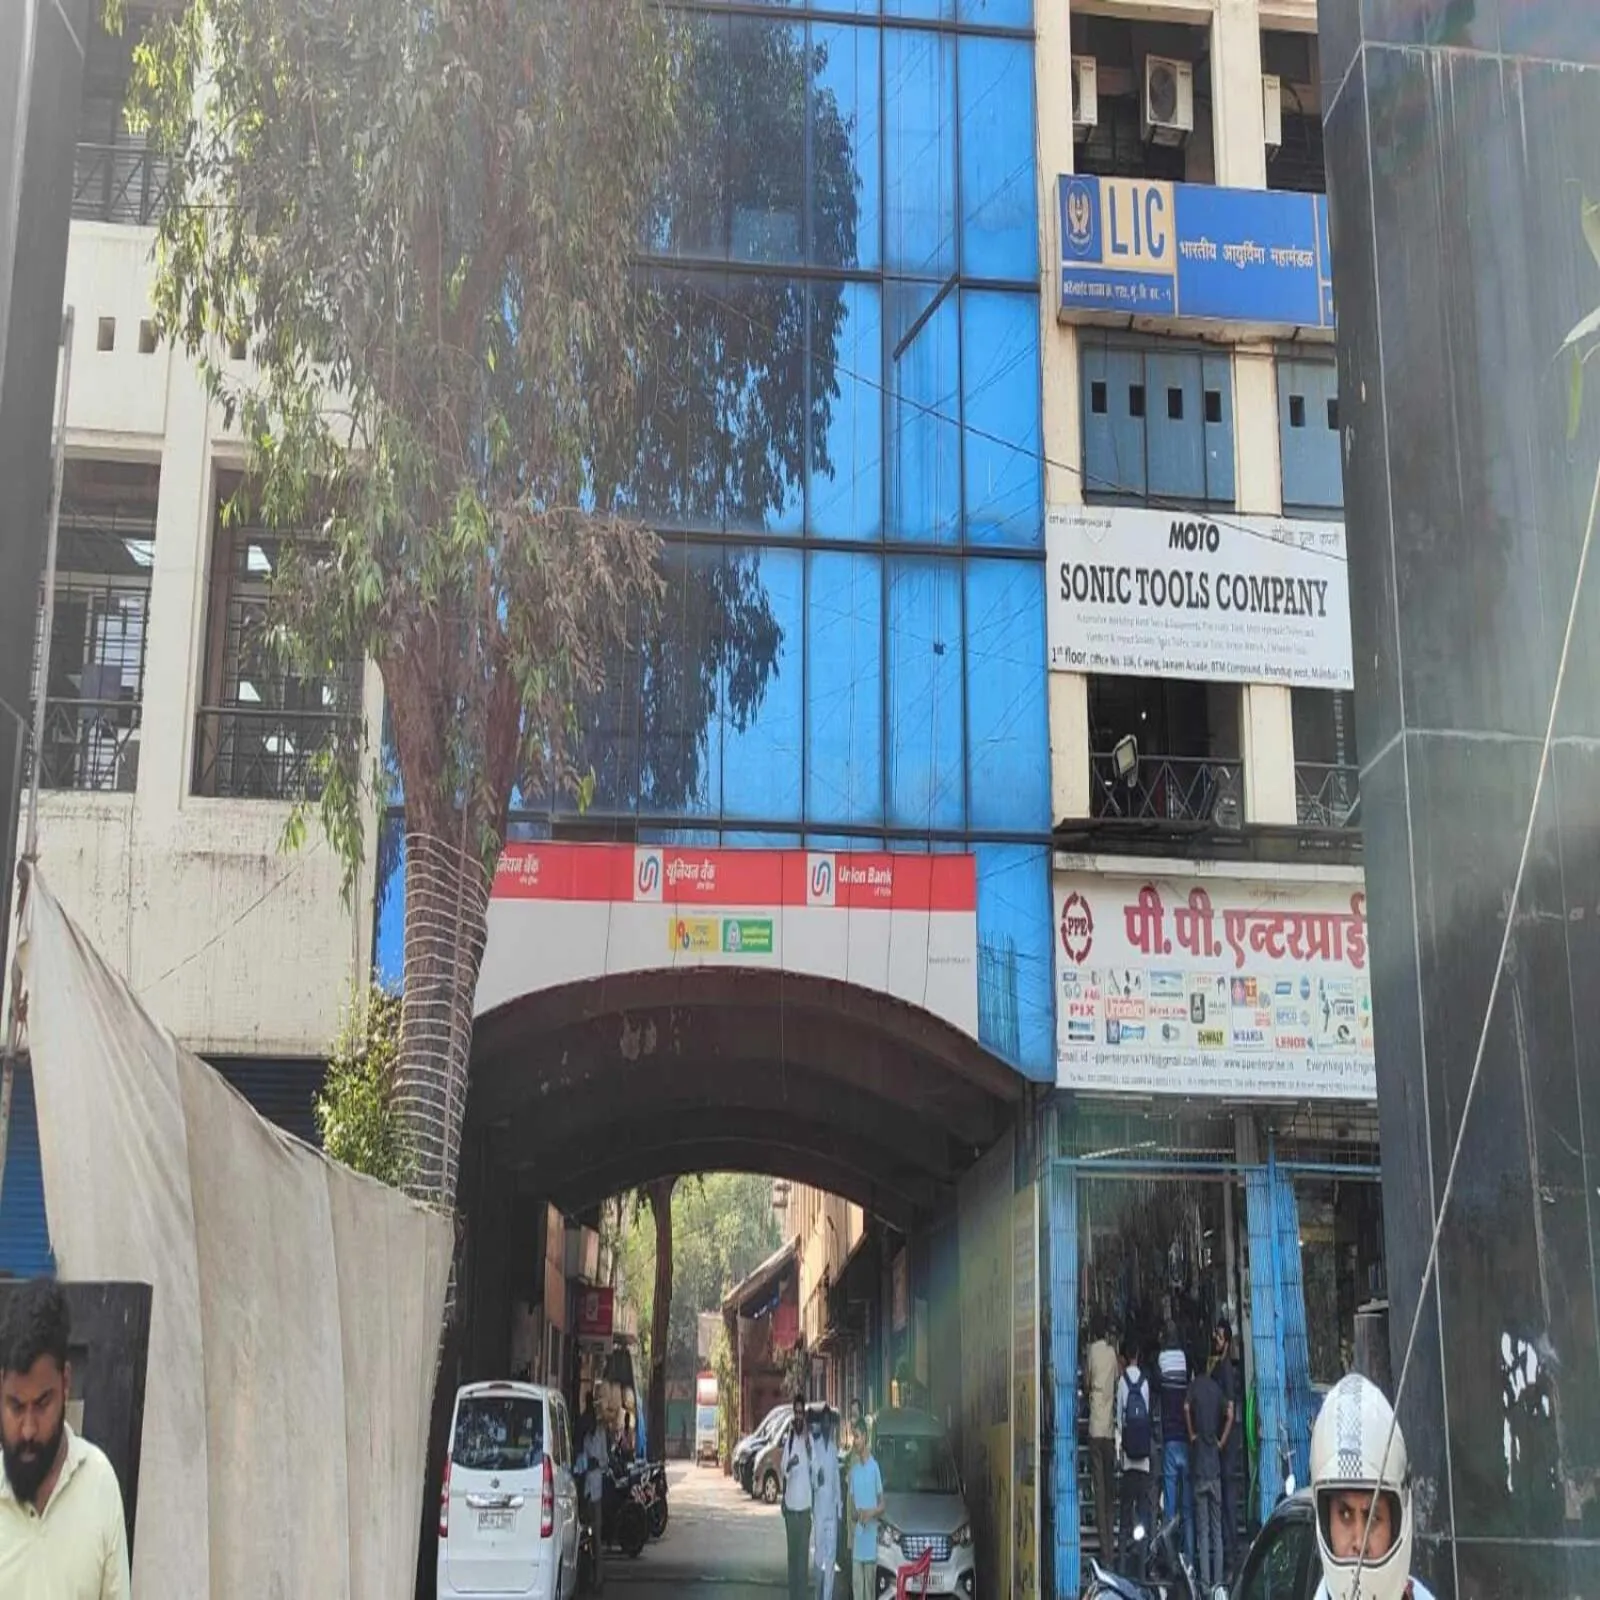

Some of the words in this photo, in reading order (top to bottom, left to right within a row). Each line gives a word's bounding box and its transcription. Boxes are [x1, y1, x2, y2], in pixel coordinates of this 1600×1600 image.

[1109, 185, 1165, 259] LIC
[1180, 237, 1217, 261] भारतीय
[1169, 521, 1220, 553] MOTO
[1060, 563, 1132, 604] SONIC
[1135, 567, 1210, 609] TOOLS
[1216, 574, 1328, 617] COMPANY
[496, 852, 522, 875] नियन
[666, 858, 699, 885] यूनियन
[838, 865, 866, 883] Union
[868, 867, 892, 884] Bank
